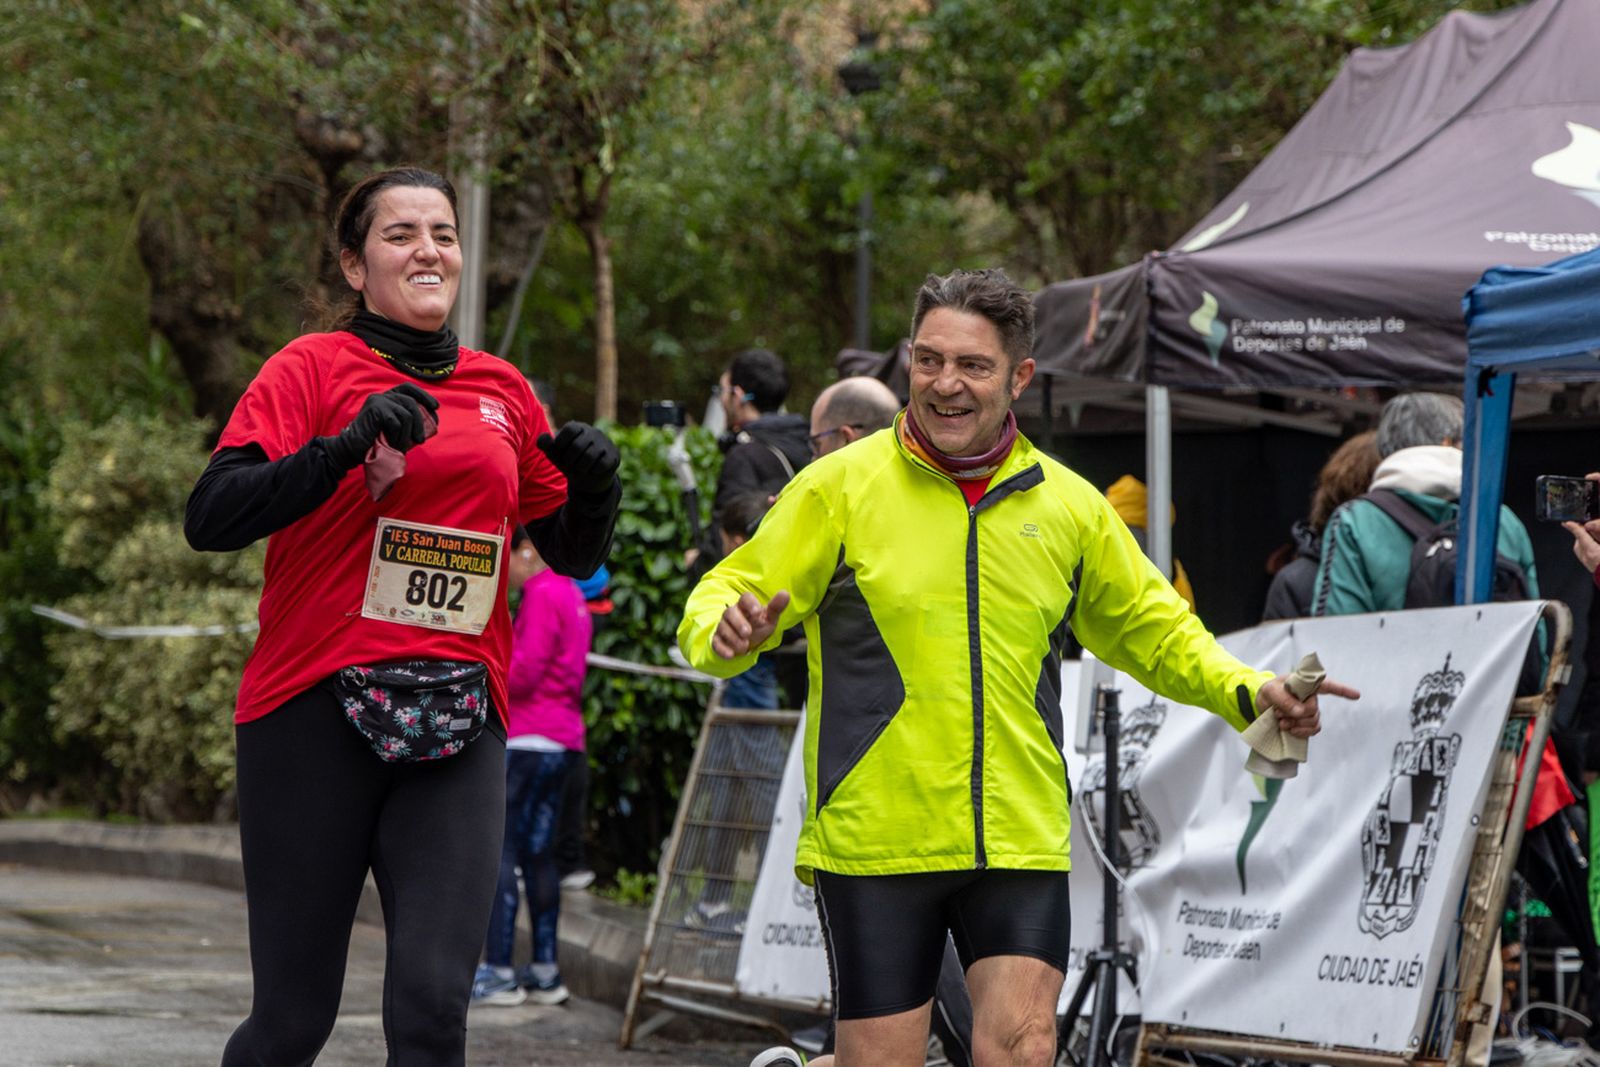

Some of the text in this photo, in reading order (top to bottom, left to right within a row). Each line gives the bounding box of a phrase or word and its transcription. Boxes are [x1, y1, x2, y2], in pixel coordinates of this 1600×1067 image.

[1484, 231, 1600, 243] Patronat
[1231, 316, 1406, 336] Patronato Municipal de
[1232, 333, 1368, 355] Deportes de Jaén
[391, 528, 492, 556] IES San Juan Bosco
[385, 543, 493, 574] V CARRERA POPULAR
[405, 569, 468, 613] 802
[1318, 953, 1424, 989] CIUDAD DE JAÉN
